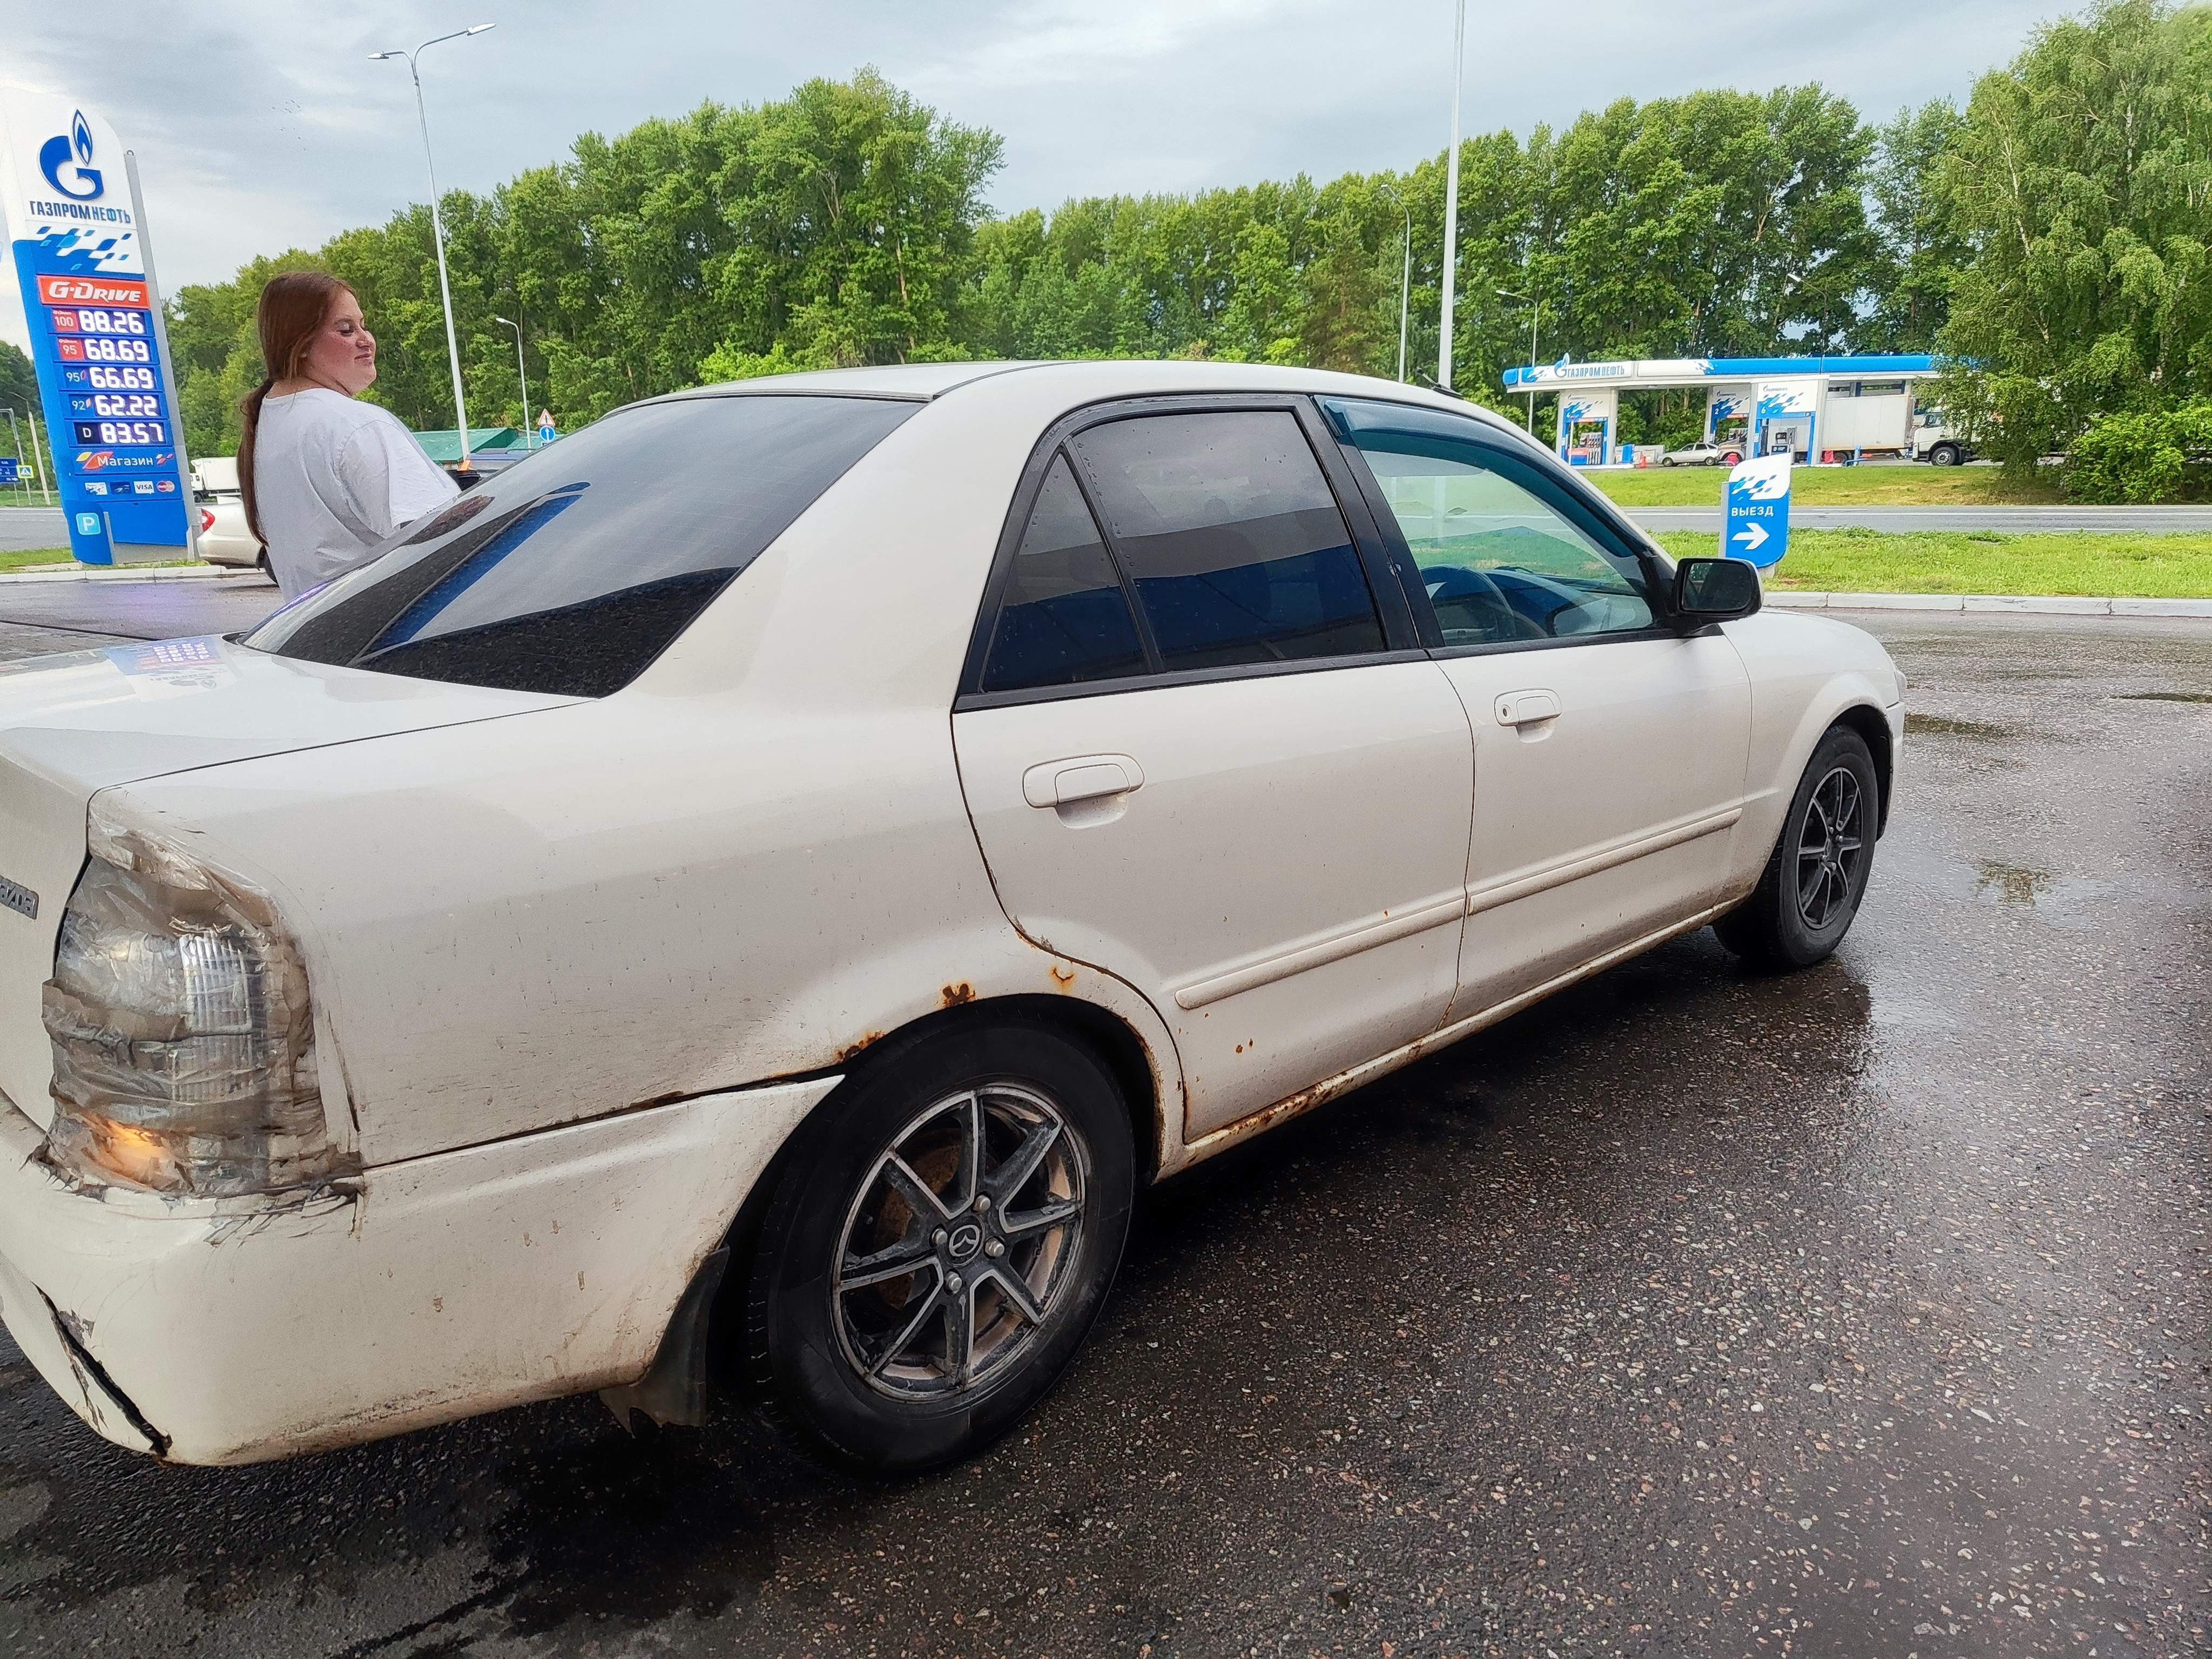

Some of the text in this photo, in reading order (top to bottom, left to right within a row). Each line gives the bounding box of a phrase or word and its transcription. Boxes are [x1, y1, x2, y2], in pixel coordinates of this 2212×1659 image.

[30, 201, 131, 224] ГАЗПРОМНЕФТЬ
[55, 310, 145, 334] 100 88.26
[63, 339, 150, 362] 95 68.69
[66, 367, 155, 389] 95 66.69
[1567, 366, 1624, 377] ГАЗПРОМНЕФТЬ
[72, 395, 159, 416] 92 62.22
[83, 423, 164, 443] D 83.57
[97, 455, 153, 466] Магазин
[1731, 506, 1773, 517] ВЫЕЗД
[82, 517, 95, 531] P
